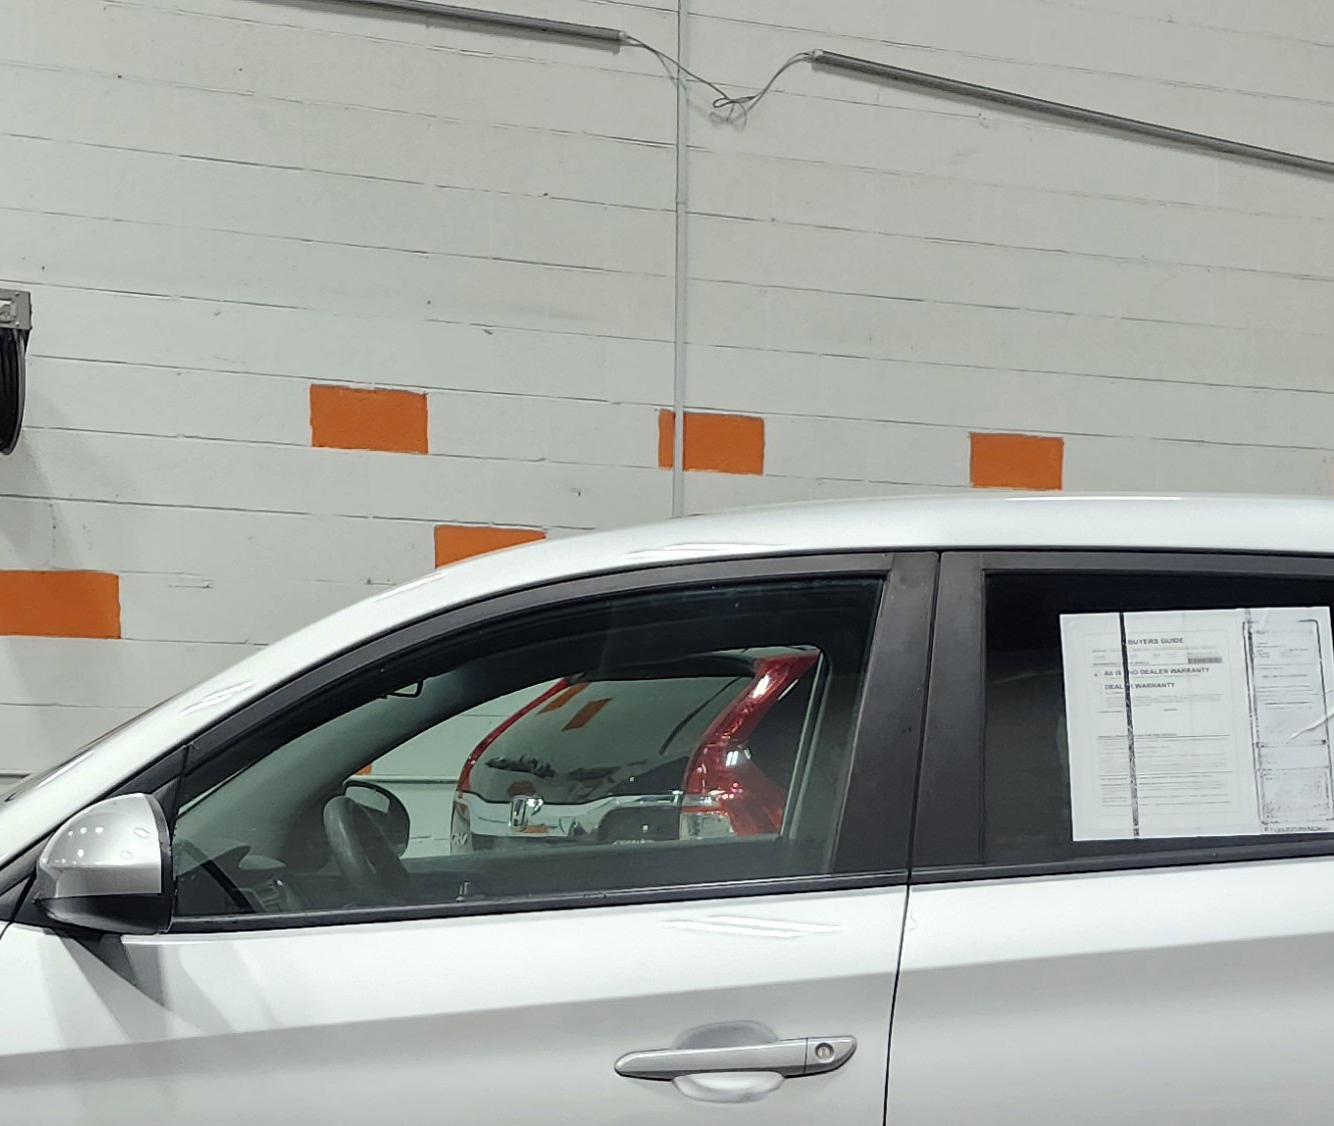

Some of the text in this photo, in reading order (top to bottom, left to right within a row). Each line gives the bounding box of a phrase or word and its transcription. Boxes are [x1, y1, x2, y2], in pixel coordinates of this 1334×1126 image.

[1127, 637, 1184, 646] BUYERS GUIDE
[1135, 682, 1176, 690] WARRANTY
